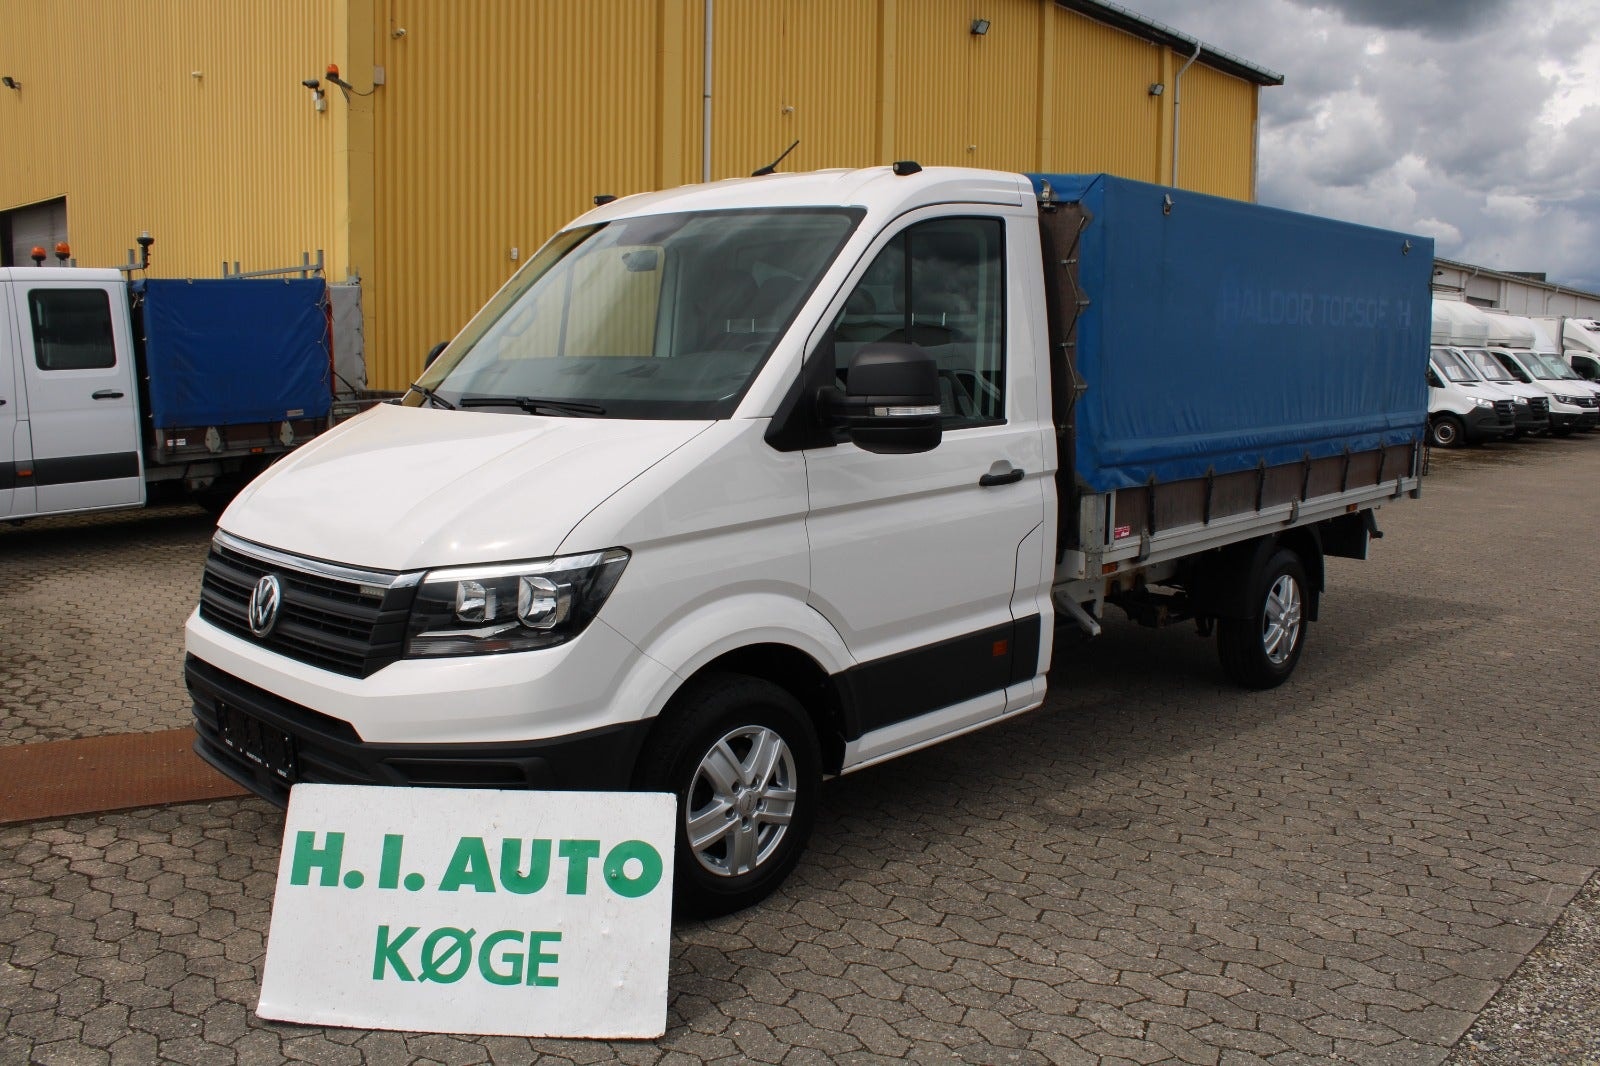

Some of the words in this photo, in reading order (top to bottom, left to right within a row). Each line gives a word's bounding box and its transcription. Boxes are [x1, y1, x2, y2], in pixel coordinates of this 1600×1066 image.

[1222, 287, 1313, 326] HALDOR
[439, 838, 662, 898] AUTO
[373, 926, 561, 986] KØGE
